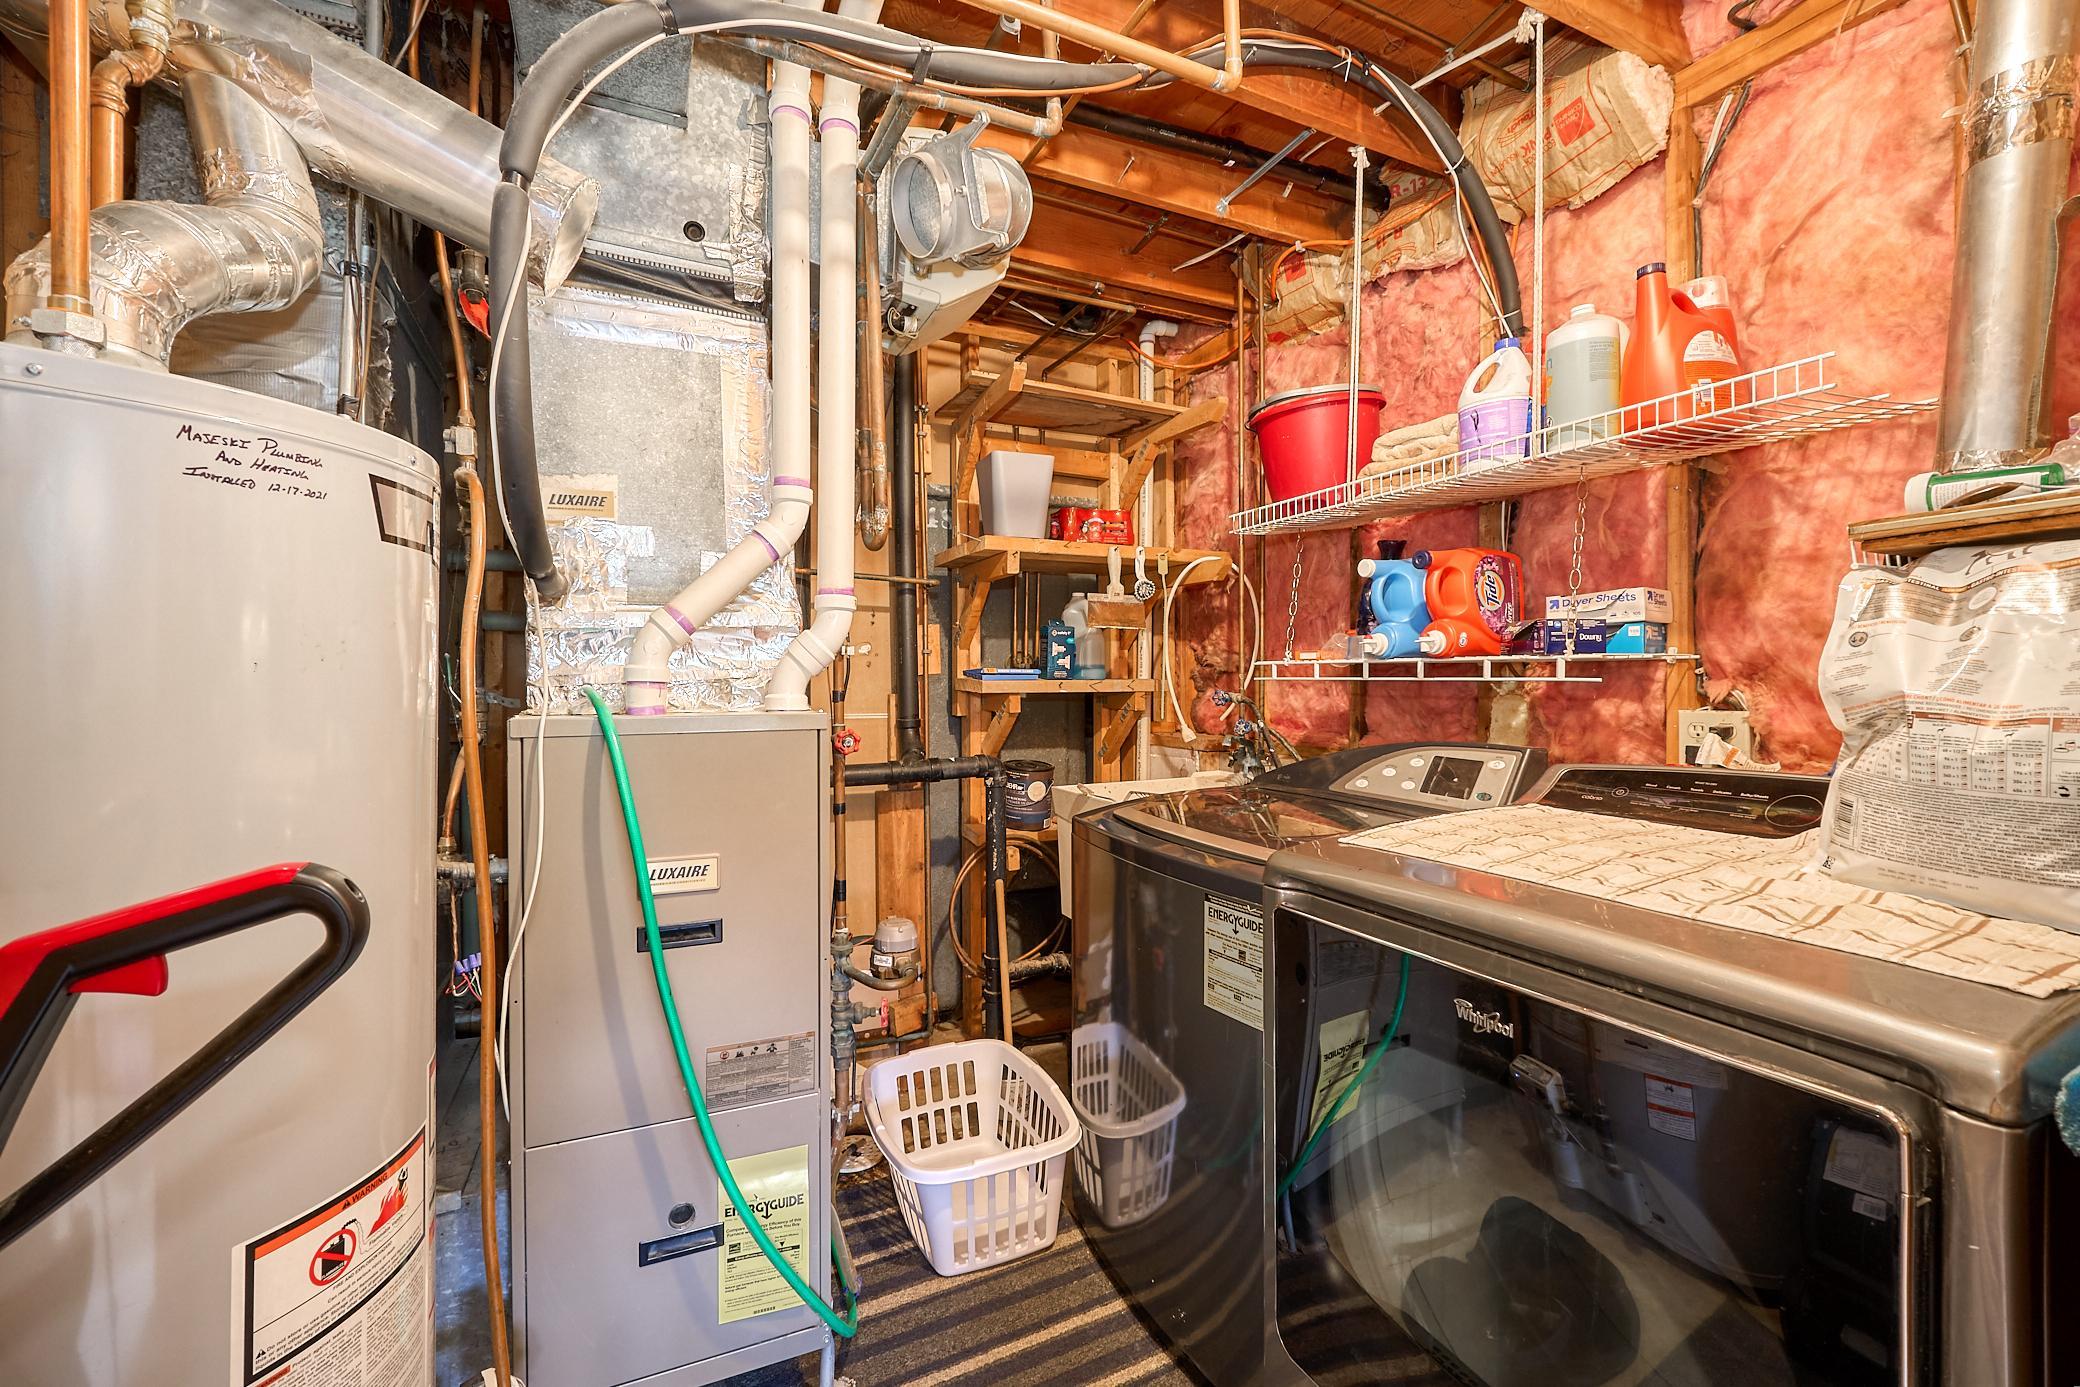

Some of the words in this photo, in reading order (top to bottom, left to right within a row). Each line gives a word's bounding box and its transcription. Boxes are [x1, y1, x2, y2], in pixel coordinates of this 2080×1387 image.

[548, 493, 608, 507] LUXAIRE
[1484, 574, 1500, 606] Tide
[1562, 596, 1594, 608] Dyer
[1595, 592, 1637, 603] Sheets
[1579, 633, 1603, 642] Downy
[650, 864, 710, 881] LUXAIRE
[1208, 907, 1264, 934] ENERGYGUIDE
[1454, 999, 1514, 1038] Whirlpool
[352, 1171, 389, 1202] WARNING
